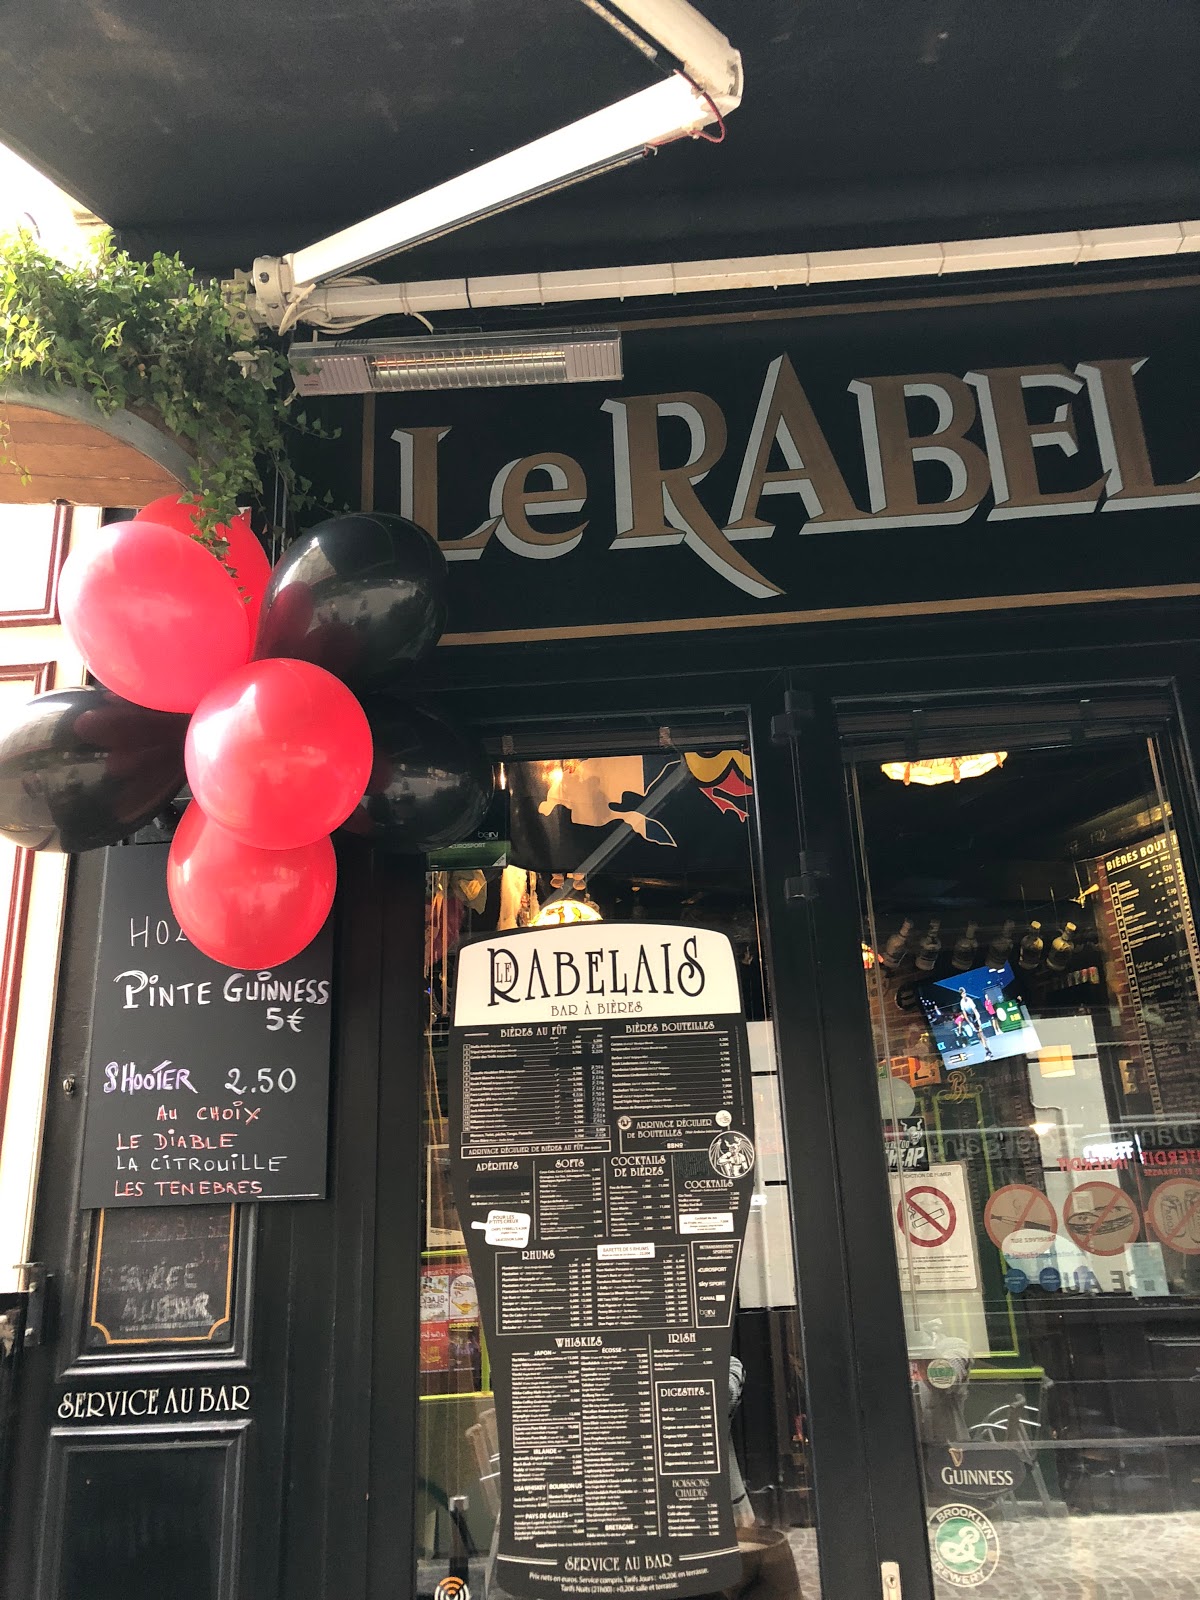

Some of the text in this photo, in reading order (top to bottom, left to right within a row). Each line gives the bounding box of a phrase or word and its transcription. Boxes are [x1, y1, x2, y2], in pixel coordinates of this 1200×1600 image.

[391, 425, 590, 561] Le
[1106, 850, 1139, 872] BIÈRES
[487, 935, 706, 1007] RABELAIS
[495, 961, 512, 984] LE
[550, 999, 643, 1017] BAR À BIÈRES
[265, 1007, 306, 1033] 5€
[625, 1020, 715, 1034] BIÈRES BOUTEILLES
[500, 1024, 568, 1038] BIÈRES AU FÛT
[223, 1066, 297, 1096] 2.50
[636, 1118, 712, 1130] ARRIVAGE RÉGULIER
[637, 1127, 683, 1139] BOUTEILLES
[116, 1132, 143, 1151] LE
[468, 1147, 499, 1156] ARRIVAGE
[500, 1145, 530, 1155] RÉGULIER
[531, 1145, 540, 1153] DE
[541, 1144, 562, 1152] BIÈRES
[573, 1142, 584, 1150] FÛT
[116, 1155, 138, 1172] LA
[555, 1158, 585, 1168] SOFTS
[610, 1154, 667, 1166] COCKTAILS
[884, 1146, 926, 1168] HEAP
[475, 1161, 519, 1172] APÉRITIFS
[614, 1164, 664, 1177] DE BIÈRES
[115, 1180, 263, 1197] LES TENEBRES
[684, 1179, 734, 1190] COCKTAILS
[521, 1249, 556, 1260] RHUMS
[555, 1336, 603, 1348] WHISKIES
[668, 1333, 697, 1344] IRISH
[660, 1387, 705, 1397] DIGESTIFS
[57, 1385, 250, 1419] SERVICE AU BAR
[672, 1479, 710, 1488] BOISSONS
[941, 1466, 1014, 1486] GUINNESS
[935, 1507, 994, 1540] BROOKLYN
[564, 1553, 673, 1572] SERVICE AU BAR
